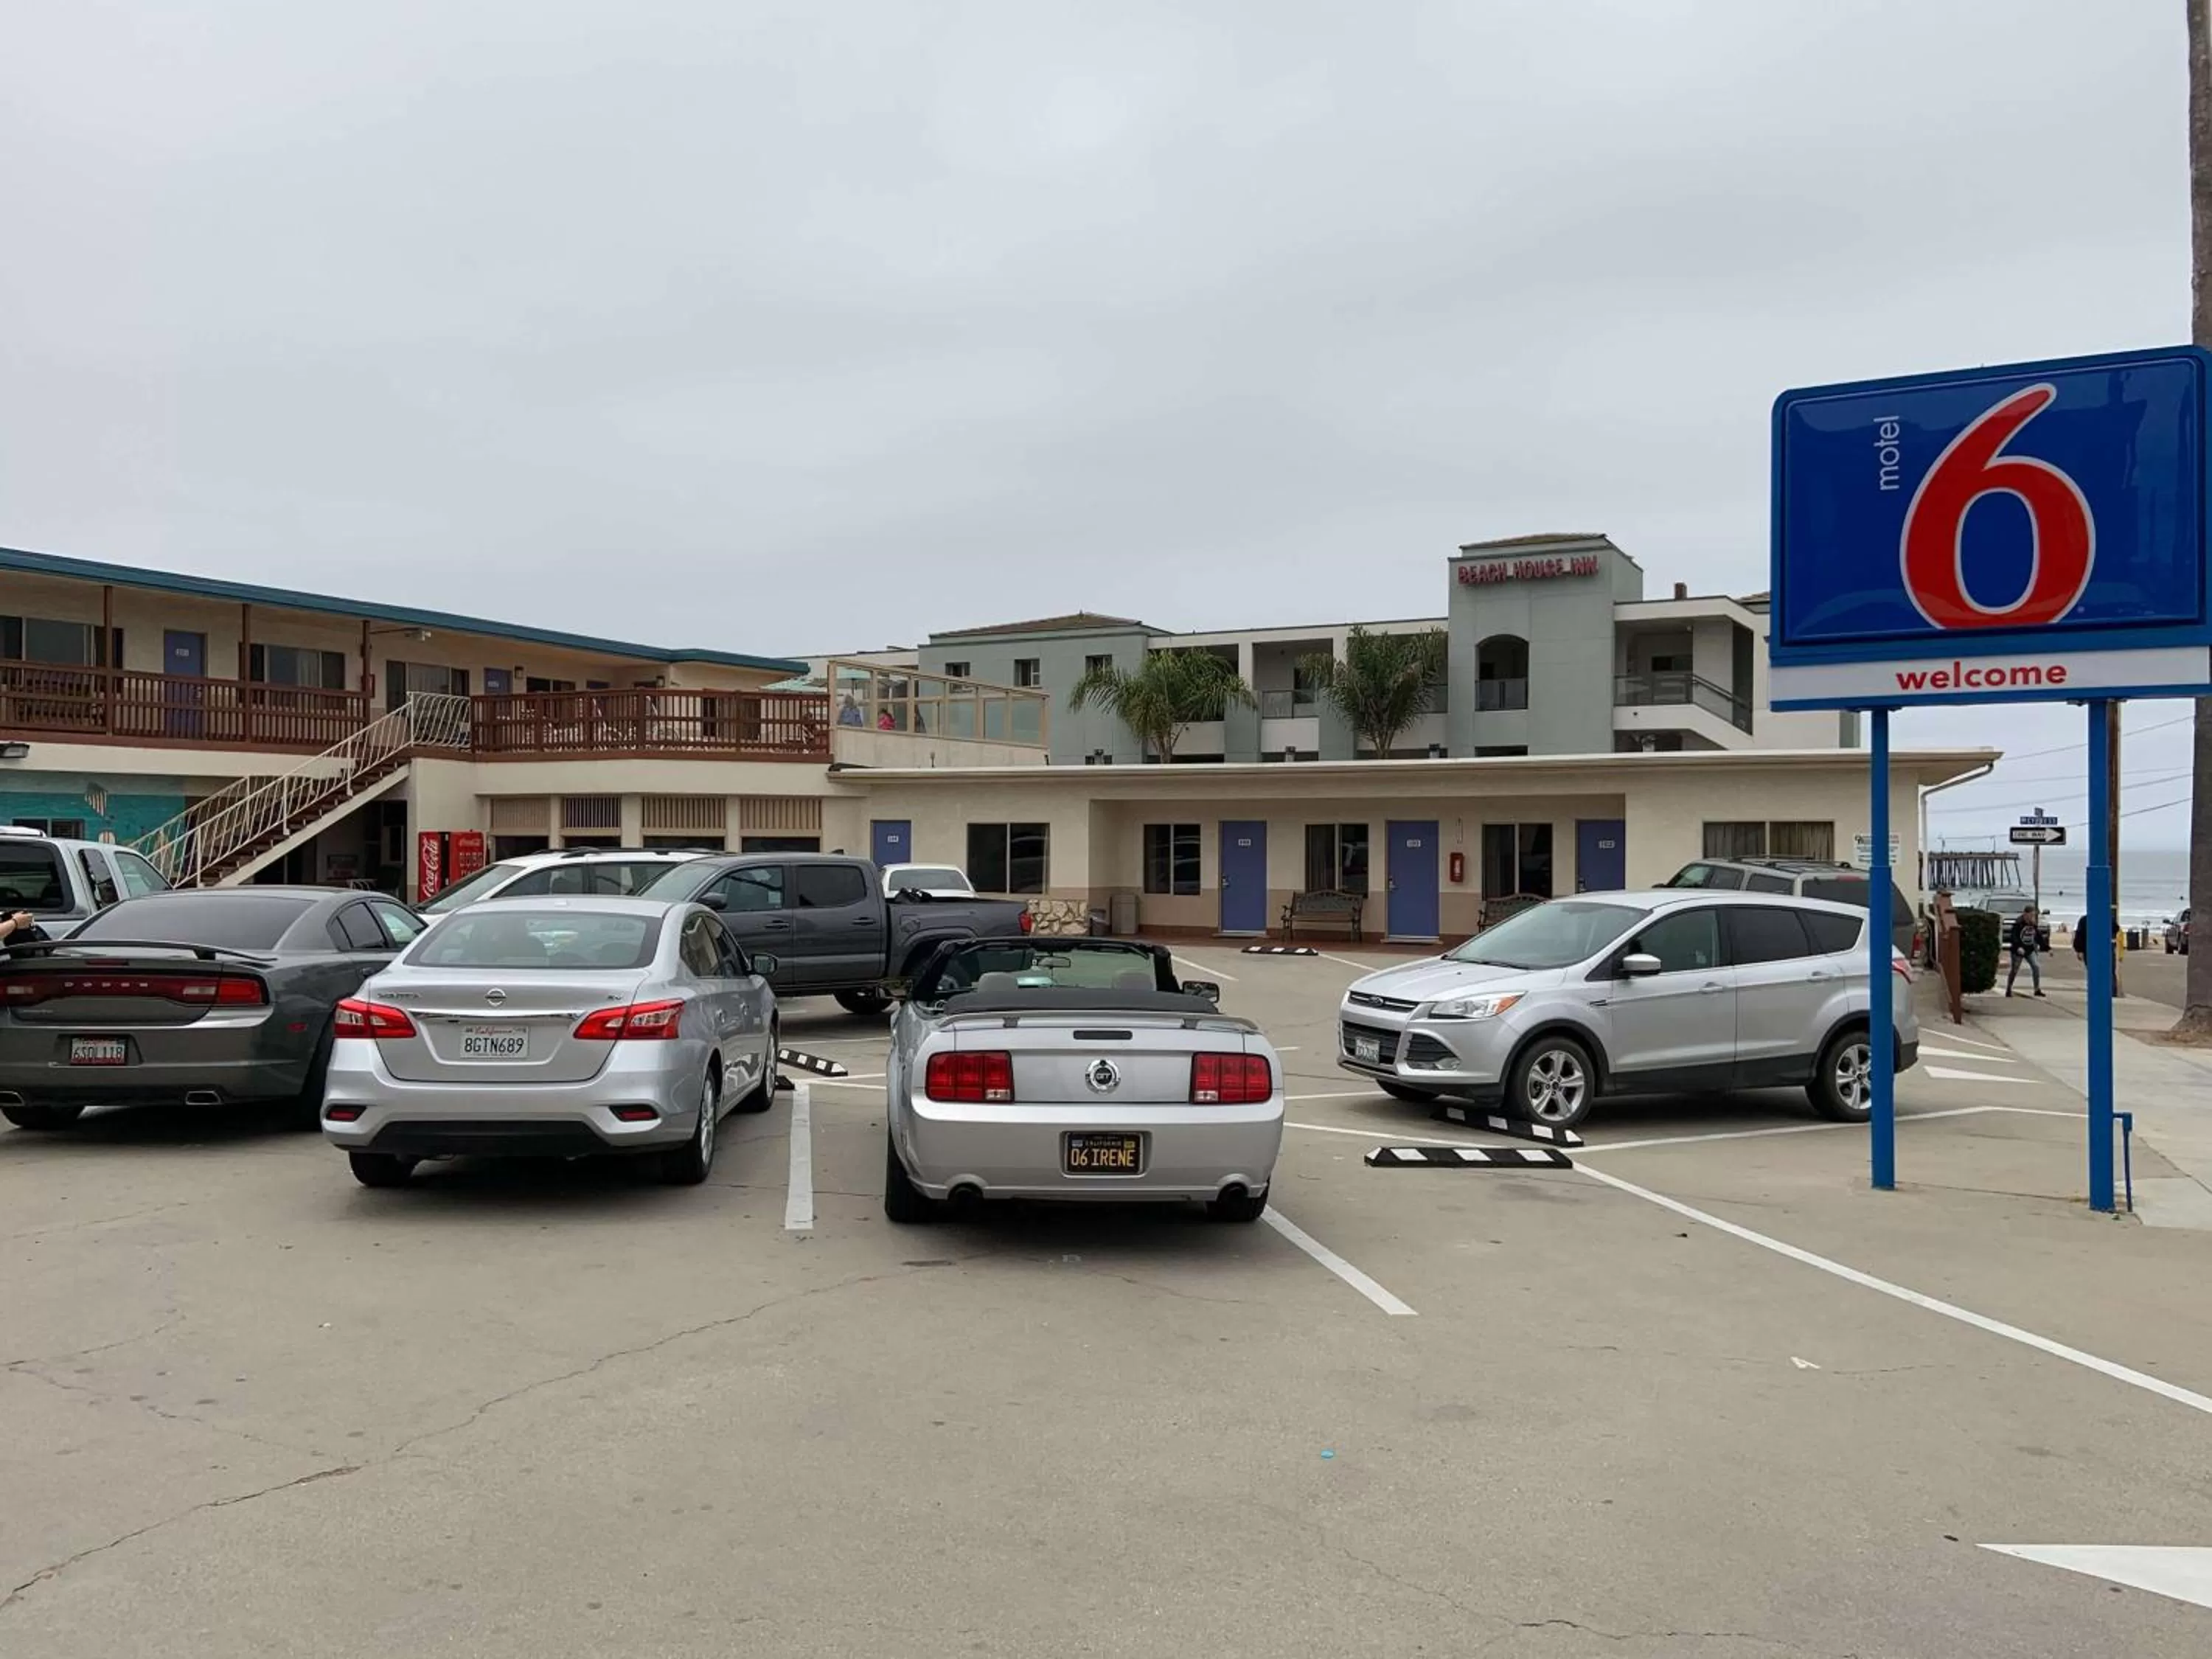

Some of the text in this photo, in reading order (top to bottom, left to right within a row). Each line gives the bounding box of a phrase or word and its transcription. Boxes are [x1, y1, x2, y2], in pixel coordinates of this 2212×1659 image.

[1873, 415, 1900, 490] motel
[1899, 382, 2097, 630] 6
[1458, 554, 1599, 585] BEACH HOUSE INN
[1896, 661, 2067, 690] welcome
[464, 1037, 525, 1054] 8GTN689
[1091, 1149, 1135, 1167] IRENE
